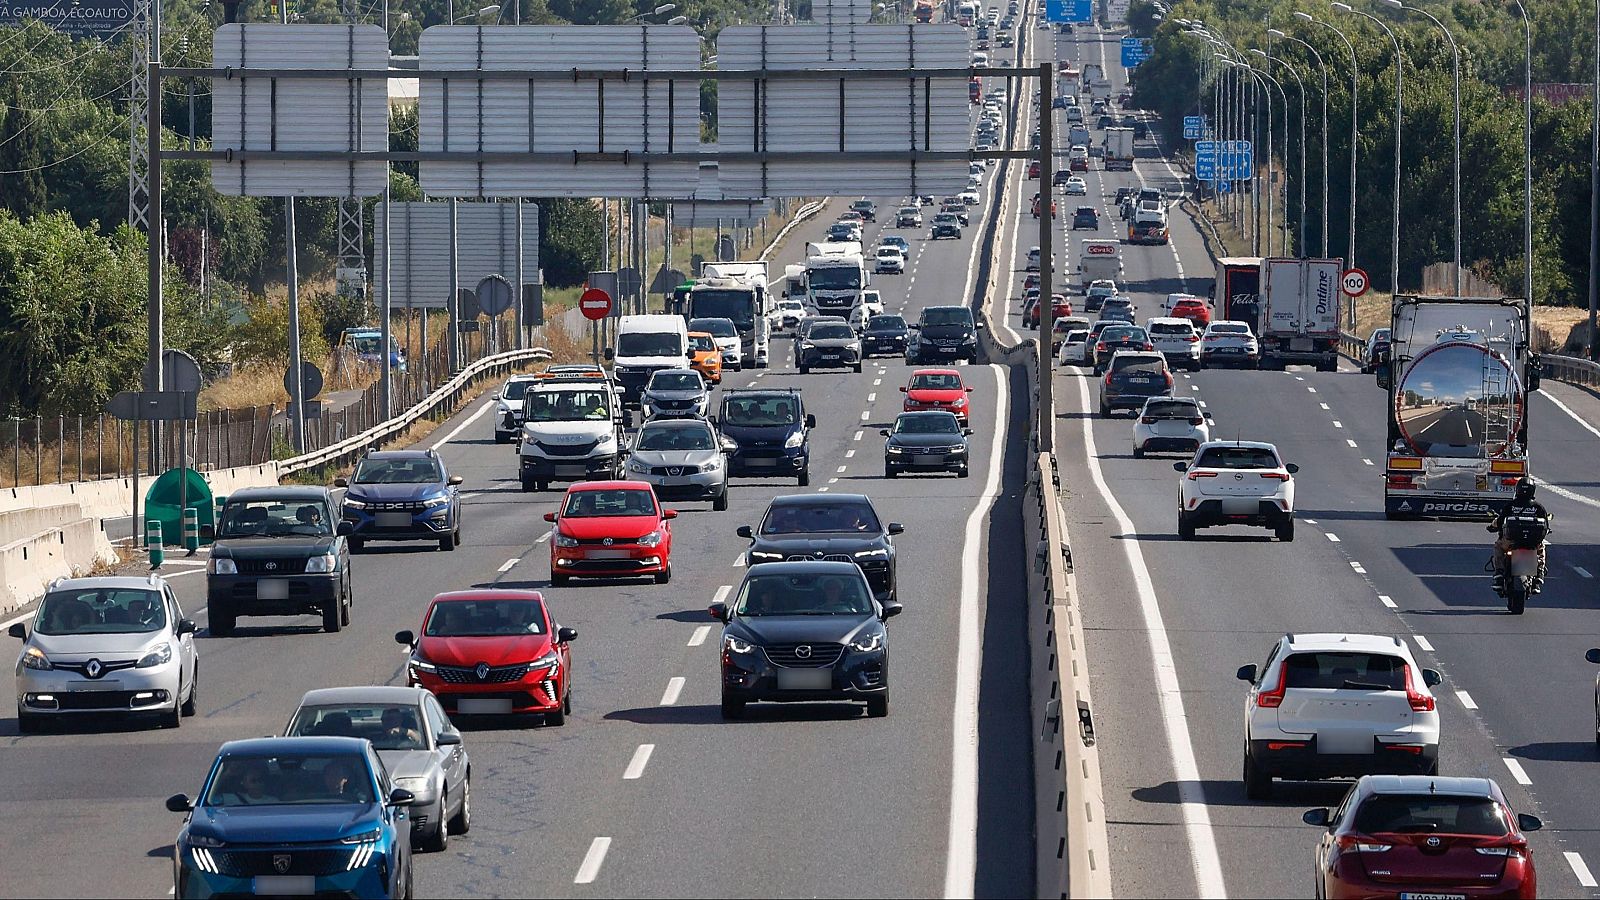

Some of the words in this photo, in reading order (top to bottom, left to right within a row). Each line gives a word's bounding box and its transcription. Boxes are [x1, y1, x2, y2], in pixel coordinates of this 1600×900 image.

[0, 6, 9, 17] A
[13, 7, 66, 18] GAMBOA
[1344, 278, 1364, 288] 100
[1316, 270, 1328, 314] Ontime
[1423, 501, 1490, 512] parcisa
